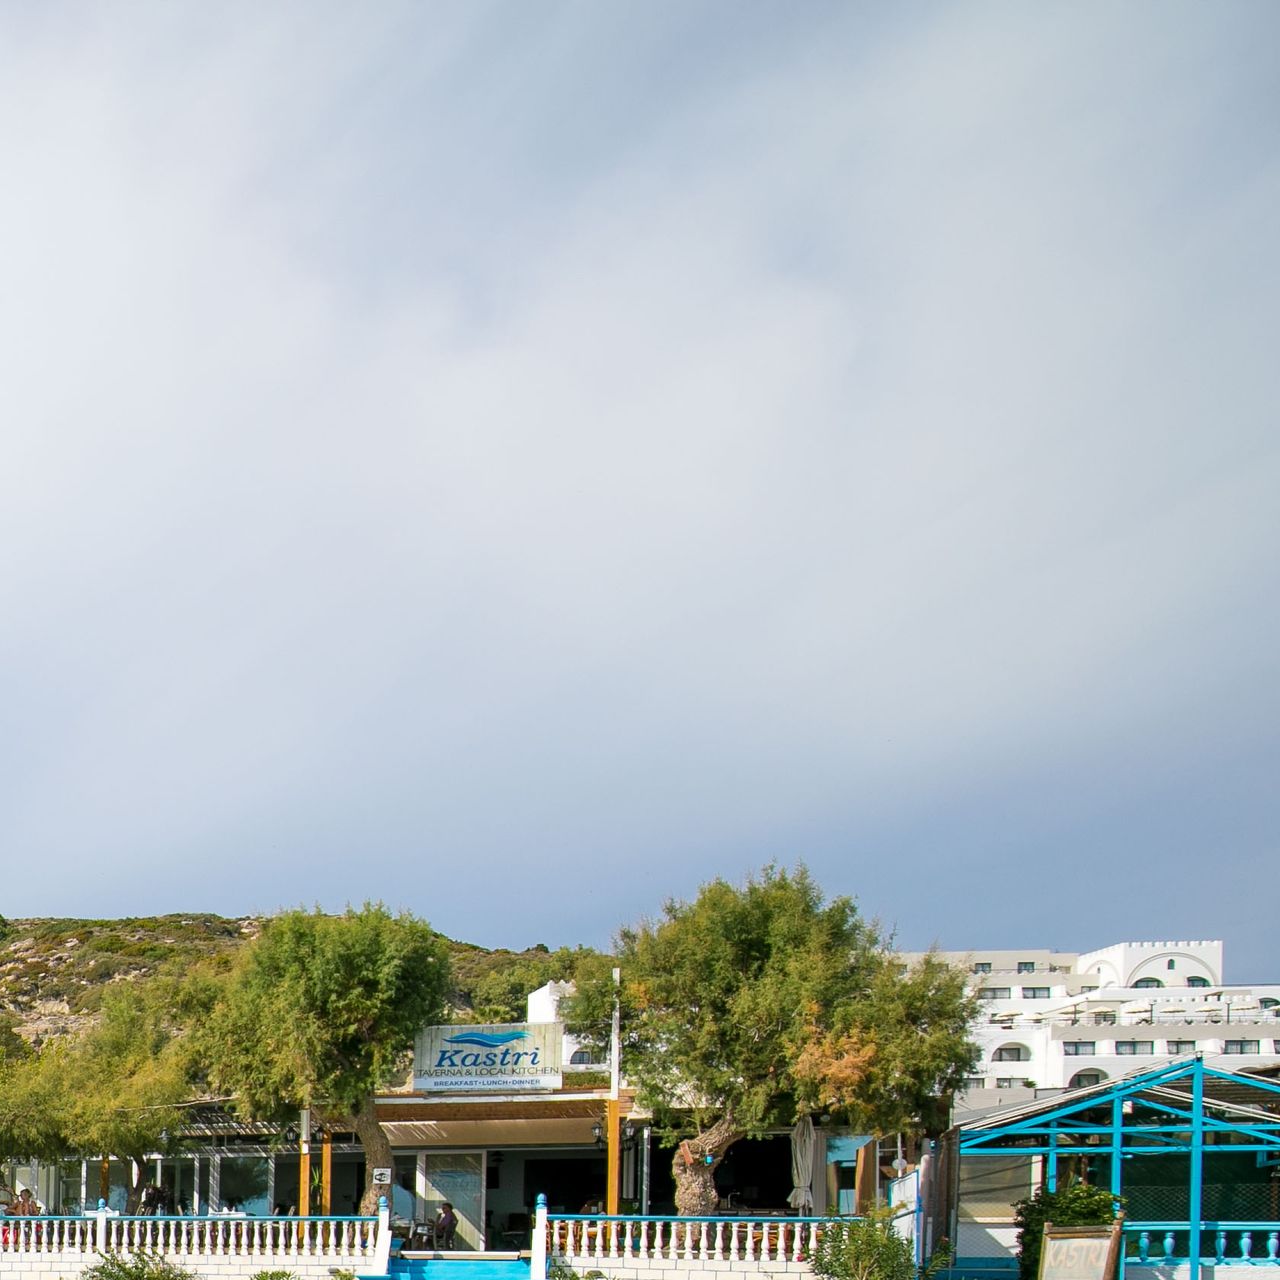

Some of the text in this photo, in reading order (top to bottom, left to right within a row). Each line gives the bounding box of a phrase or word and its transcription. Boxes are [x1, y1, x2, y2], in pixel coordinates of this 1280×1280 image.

[435, 1047, 541, 1067] Kastri
[418, 1066, 559, 1077] TAVERNA & LOCAL KITCHEN
